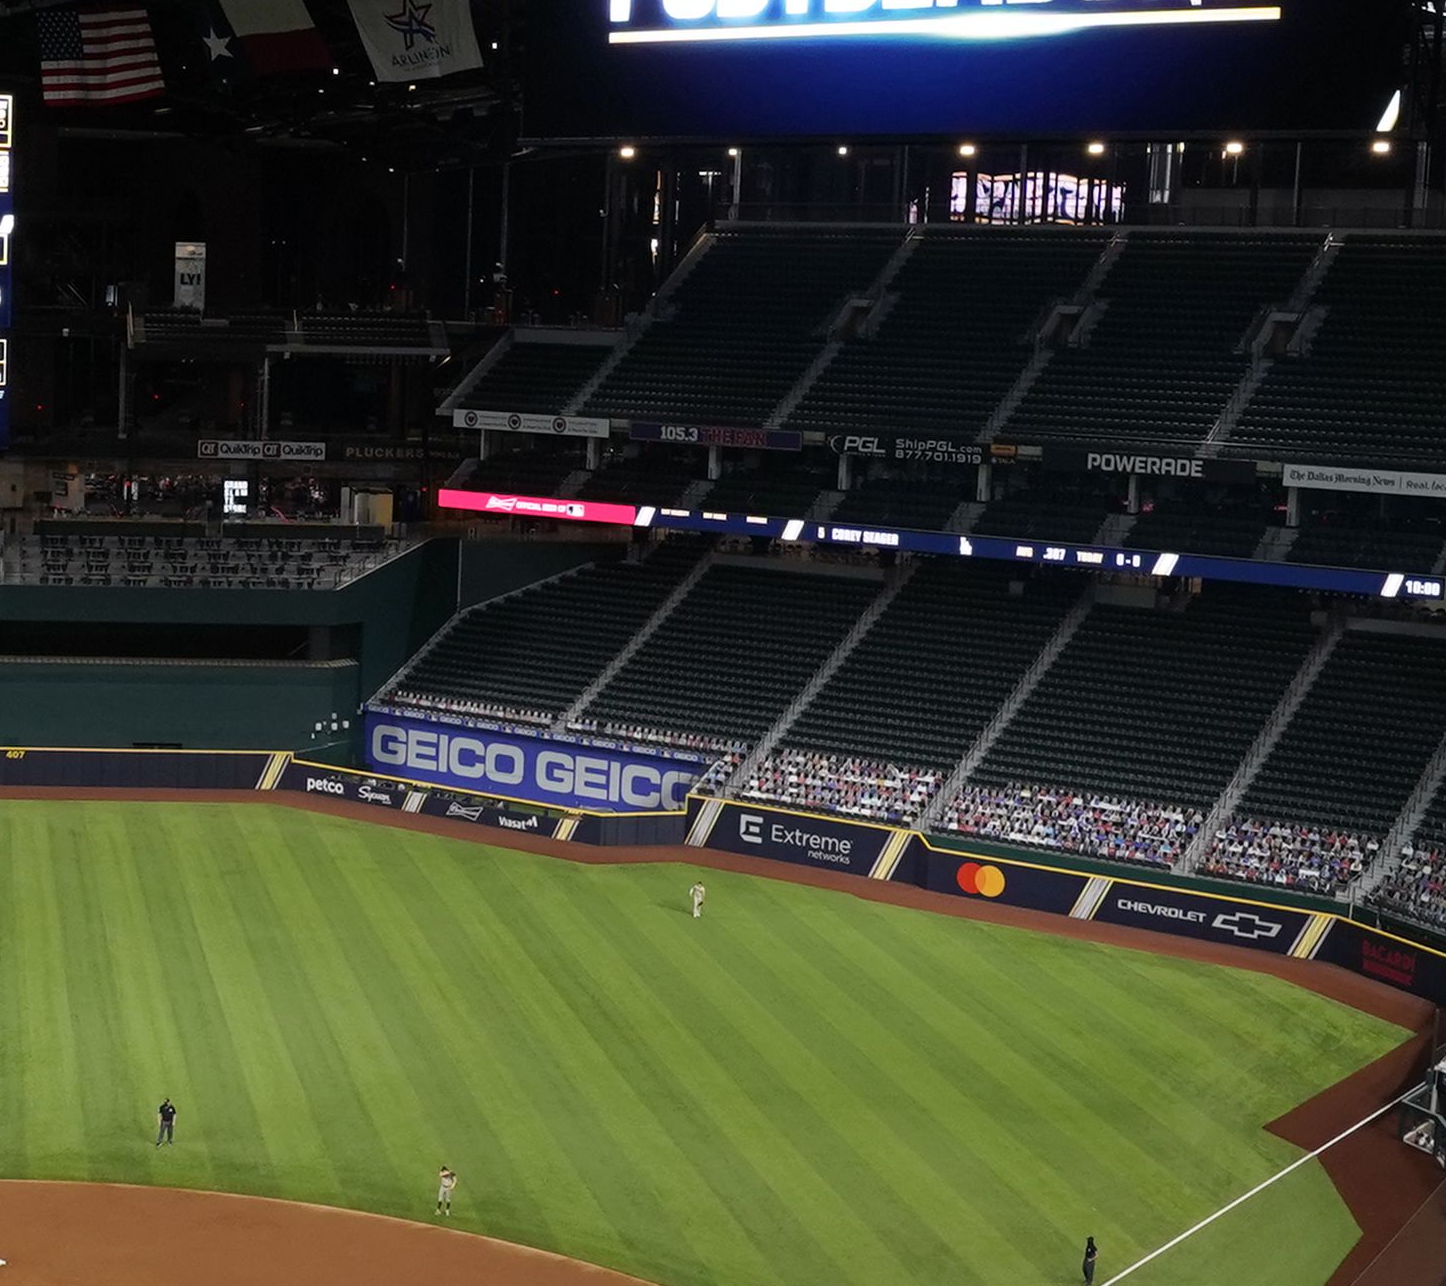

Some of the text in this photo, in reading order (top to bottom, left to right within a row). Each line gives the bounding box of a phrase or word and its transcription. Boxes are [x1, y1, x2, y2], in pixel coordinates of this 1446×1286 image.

[660, 426, 699, 443] 105.3
[220, 443, 260, 457] QuikTrip
[283, 445, 323, 459] QuikTrip
[346, 446, 425, 459] PLUCKERS
[844, 435, 886, 455] PGL
[1087, 451, 1204, 478] POWERADE
[1405, 580, 1440, 596] 10:00
[372, 724, 525, 785] GEICO
[771, 824, 850, 855] Extreme
[808, 849, 851, 866] networks
[1117, 898, 1207, 923] CHEVROLET
